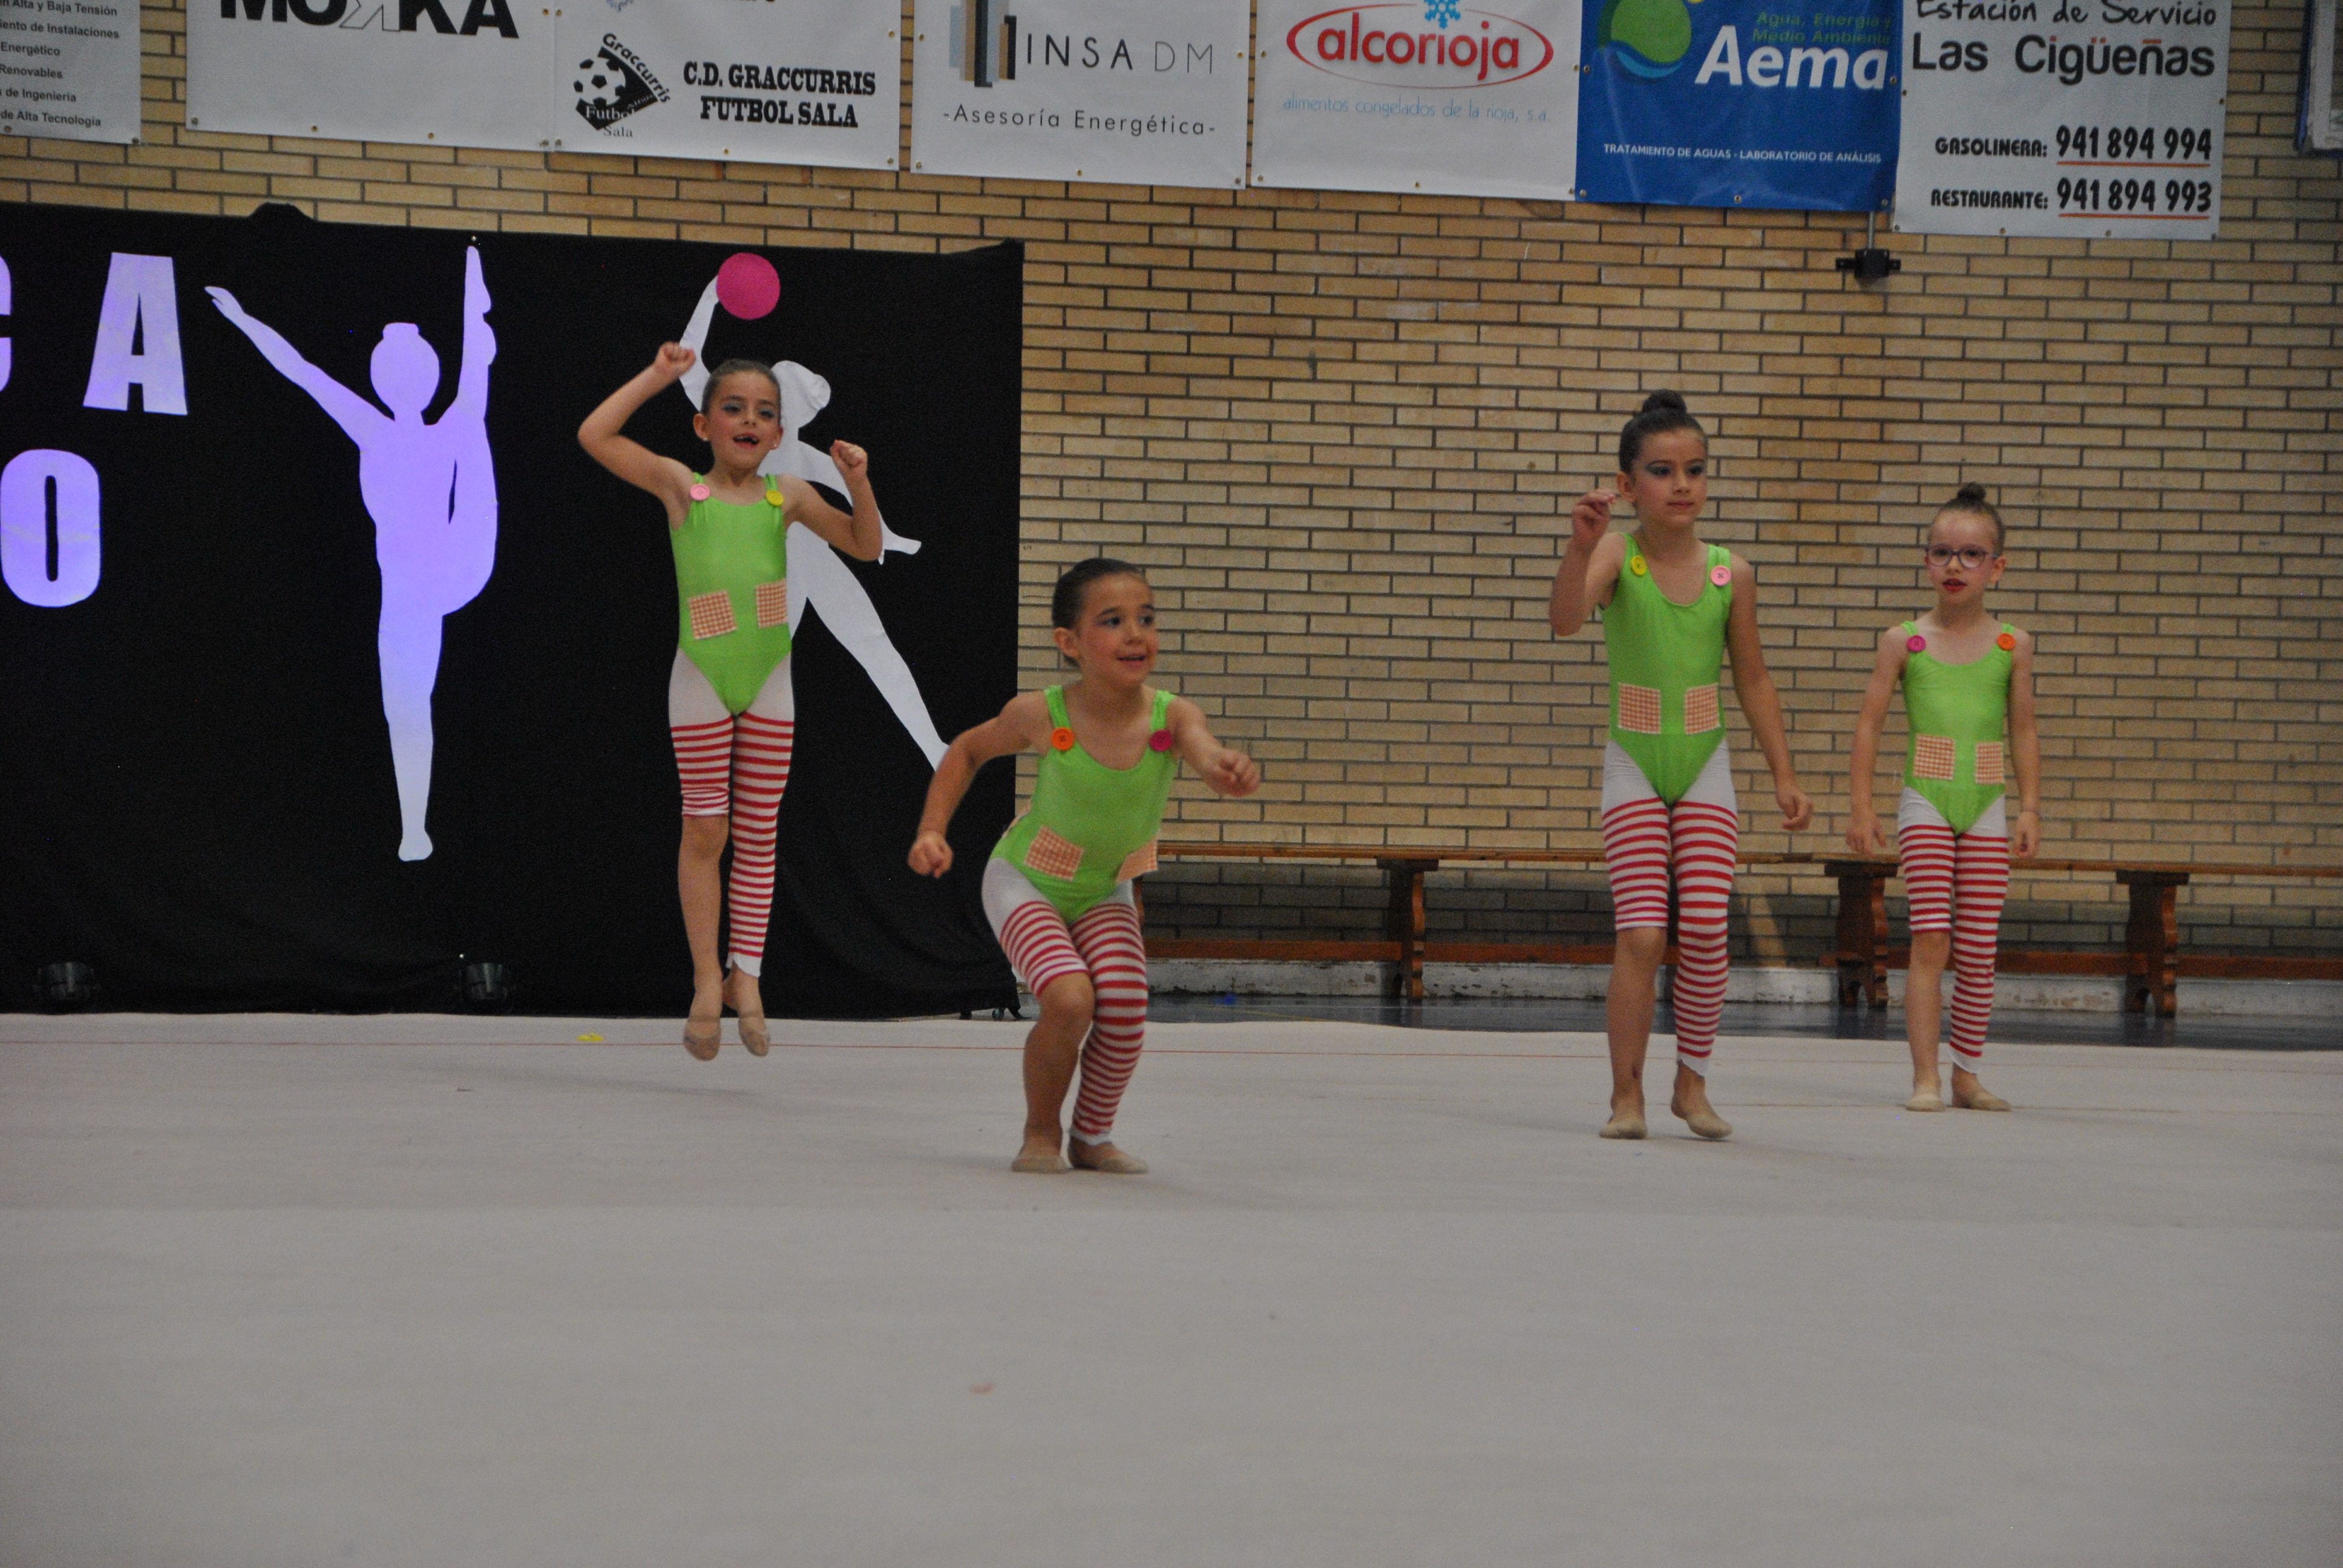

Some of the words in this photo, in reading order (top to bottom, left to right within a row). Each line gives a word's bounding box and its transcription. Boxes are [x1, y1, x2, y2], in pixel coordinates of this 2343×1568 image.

[13, 0, 34, 9] Alta
[38, 2, 44, 12] y
[47, 1, 71, 14] Baja
[75, 3, 117, 16] Tensión
[1917, 0, 2037, 22] Estación
[2053, 0, 2088, 22] de
[2102, 0, 2217, 26] Servicio
[31, 22, 44, 33] de
[47, 23, 119, 39] Instalaciones
[1752, 29, 1806, 42] Medio
[1, 42, 61, 56] Energético
[1027, 33, 1133, 71] INSA
[1155, 41, 1213, 74] DM
[1317, 10, 1519, 81] alcorioja
[1694, 25, 1888, 90] Aema
[1912, 32, 1988, 71] Las
[2015, 34, 2215, 85] Cigüeñas
[0, 64, 63, 79] Renovables
[602, 33, 670, 103] Graccurris
[683, 61, 723, 88] C.D.
[728, 64, 876, 96] GRACCURRIS
[5, 87, 19, 97] de
[1283, 91, 1349, 112] alimentos
[1355, 95, 1435, 117] congelados
[1442, 97, 1463, 117] de
[1469, 98, 1480, 118] la
[1, 110, 14, 120] de
[17, 111, 39, 121] Alta
[700, 96, 794, 124] FUTBOL
[798, 101, 859, 128] SALA
[603, 125, 634, 138] Sala
[1935, 137, 2048, 158] GASOLINERA:
[2057, 125, 2100, 158] 941
[2107, 126, 2154, 159] 894
[2164, 127, 2212, 160] 994
[1604, 143, 1675, 157] TRATAMIENTO
[1677, 147, 1691, 157] DE
[1694, 148, 1731, 159] AGUAS
[1740, 149, 1816, 162] LABORATORIO
[1819, 152, 1833, 162] DE
[1931, 188, 2048, 209] RESTAURANTE:
[2057, 177, 2100, 211] 941
[2108, 178, 2156, 212] 894
[2166, 179, 2212, 212] 993
